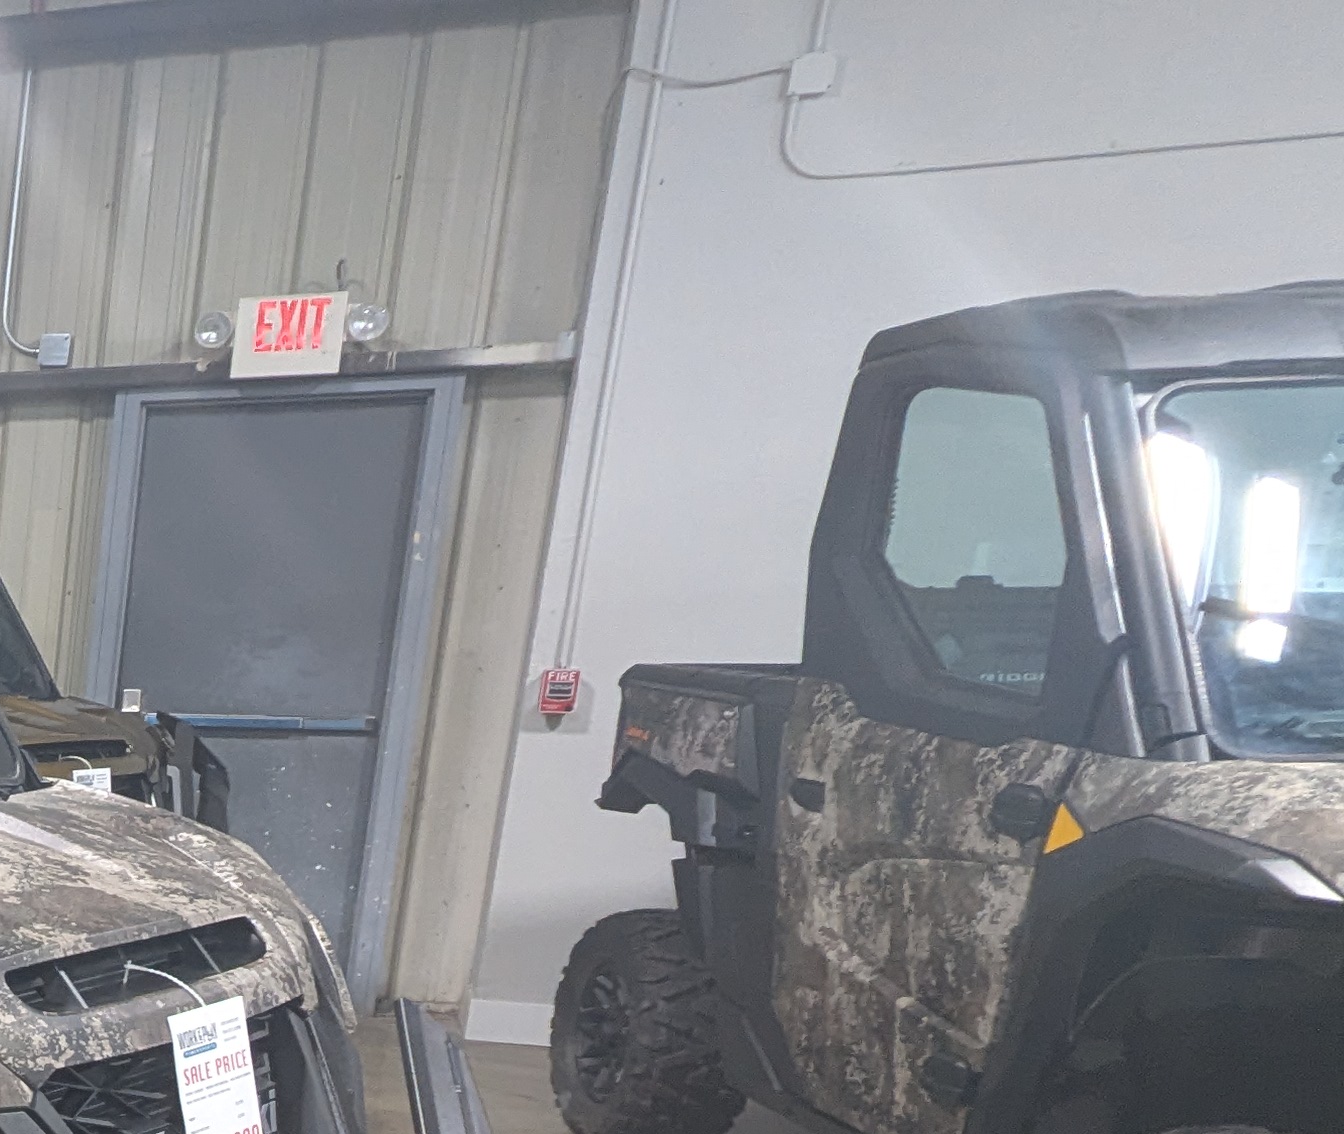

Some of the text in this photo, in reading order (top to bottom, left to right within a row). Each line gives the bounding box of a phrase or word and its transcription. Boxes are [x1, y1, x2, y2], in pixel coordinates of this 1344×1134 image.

[252, 296, 333, 353] EXIT
[547, 671, 577, 681] FIRE
[183, 1061, 212, 1086] SALE
[215, 1049, 249, 1076] PRICE
